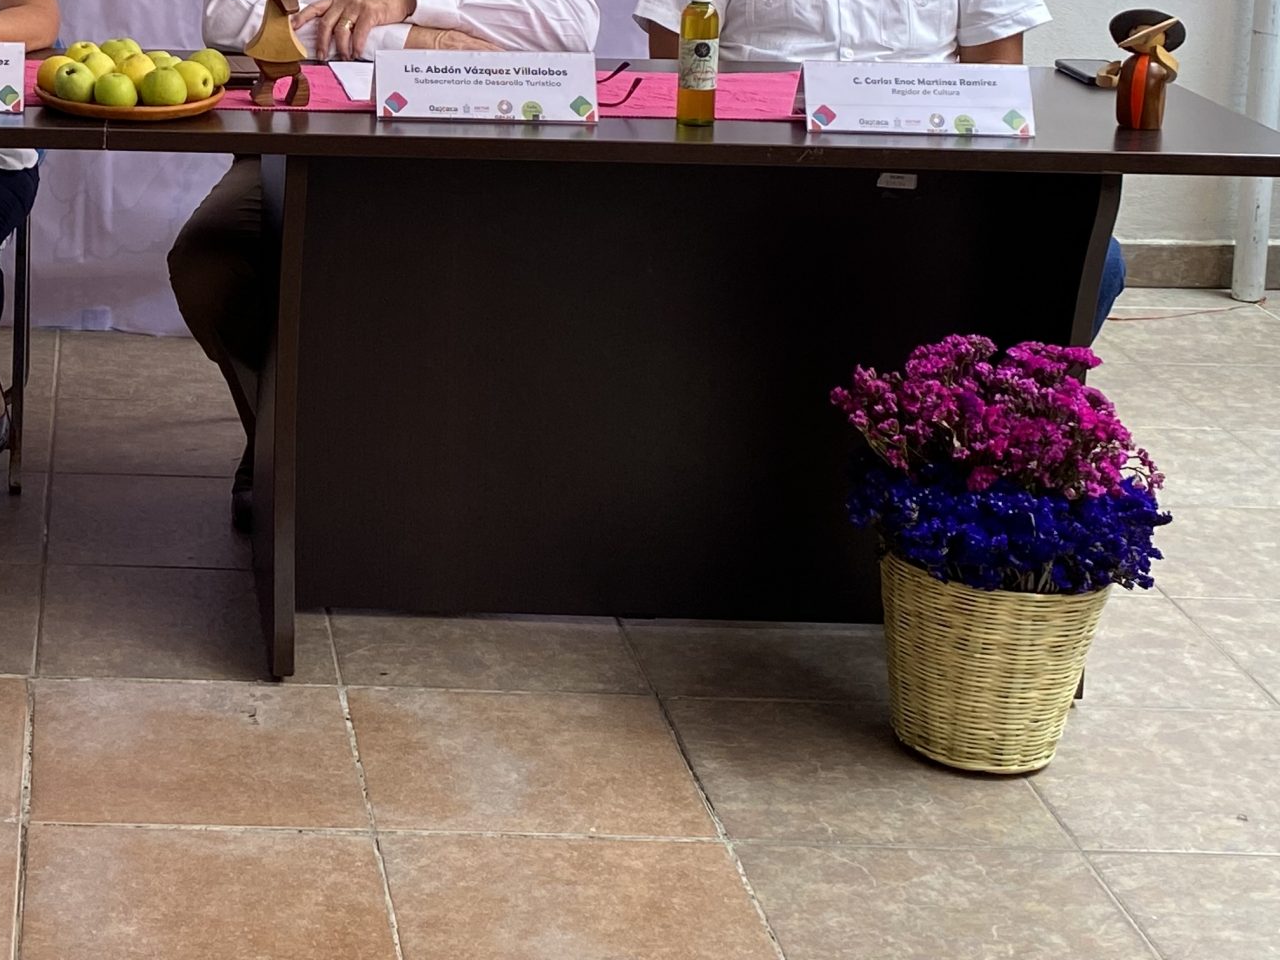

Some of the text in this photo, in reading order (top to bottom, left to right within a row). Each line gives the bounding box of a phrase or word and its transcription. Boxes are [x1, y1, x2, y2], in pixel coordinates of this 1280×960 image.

[404, 64, 568, 77] Lic. Abdón Vázquez Villalobos
[414, 77, 472, 86] Subsecretario
[473, 78, 483, 86] de
[853, 77, 863, 85] C.
[865, 77, 892, 86] Carlos
[894, 77, 916, 86] Enoc
[891, 88, 920, 97] Regidor
[933, 89, 960, 97] Cultura
